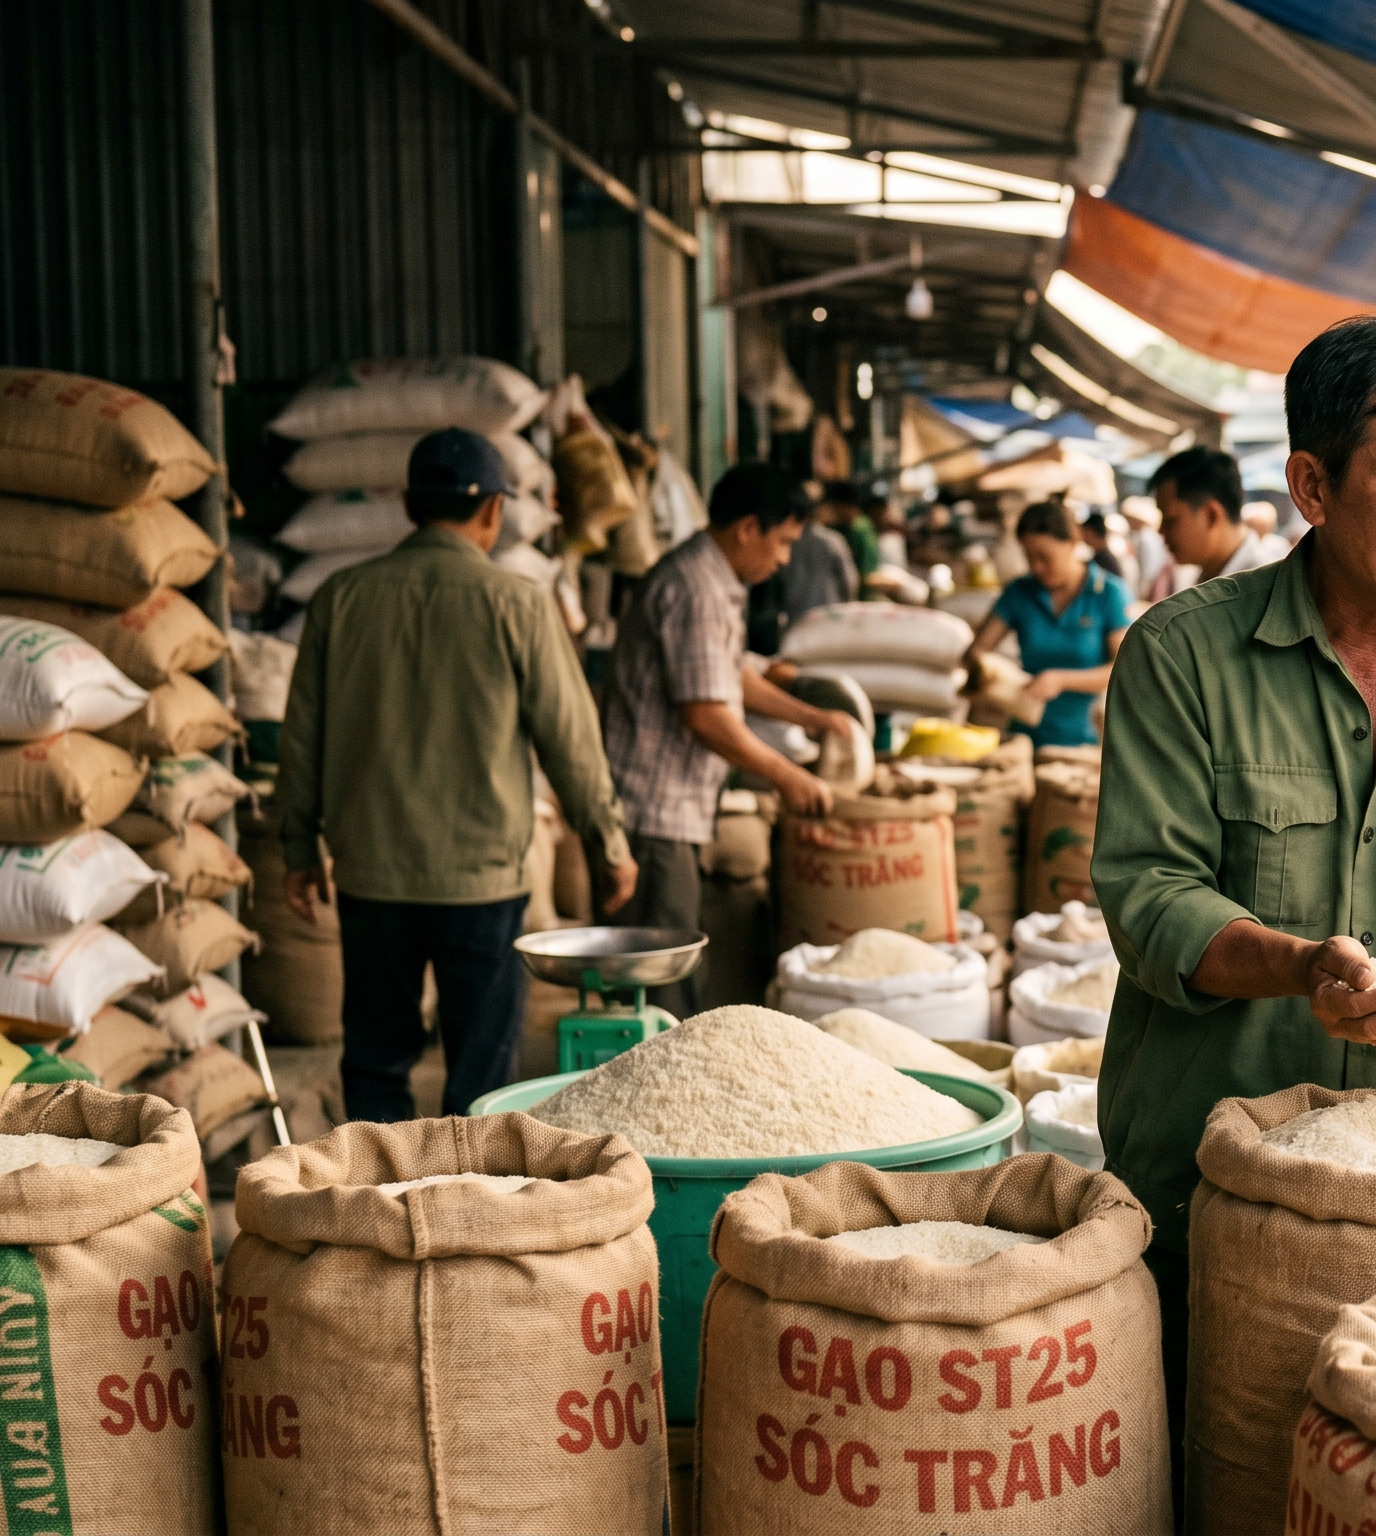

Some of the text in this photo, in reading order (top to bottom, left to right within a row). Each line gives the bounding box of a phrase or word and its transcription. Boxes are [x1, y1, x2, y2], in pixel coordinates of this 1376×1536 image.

[117, 1269, 200, 1351] GẠO
[580, 1280, 653, 1365] GẠO
[97, 1356, 196, 1436] SÓC
[777, 1318, 1098, 1418] GẠO ST25
[555, 1370, 649, 1454] SÓC
[754, 1409, 1121, 1514] SÓC TRĂNG
